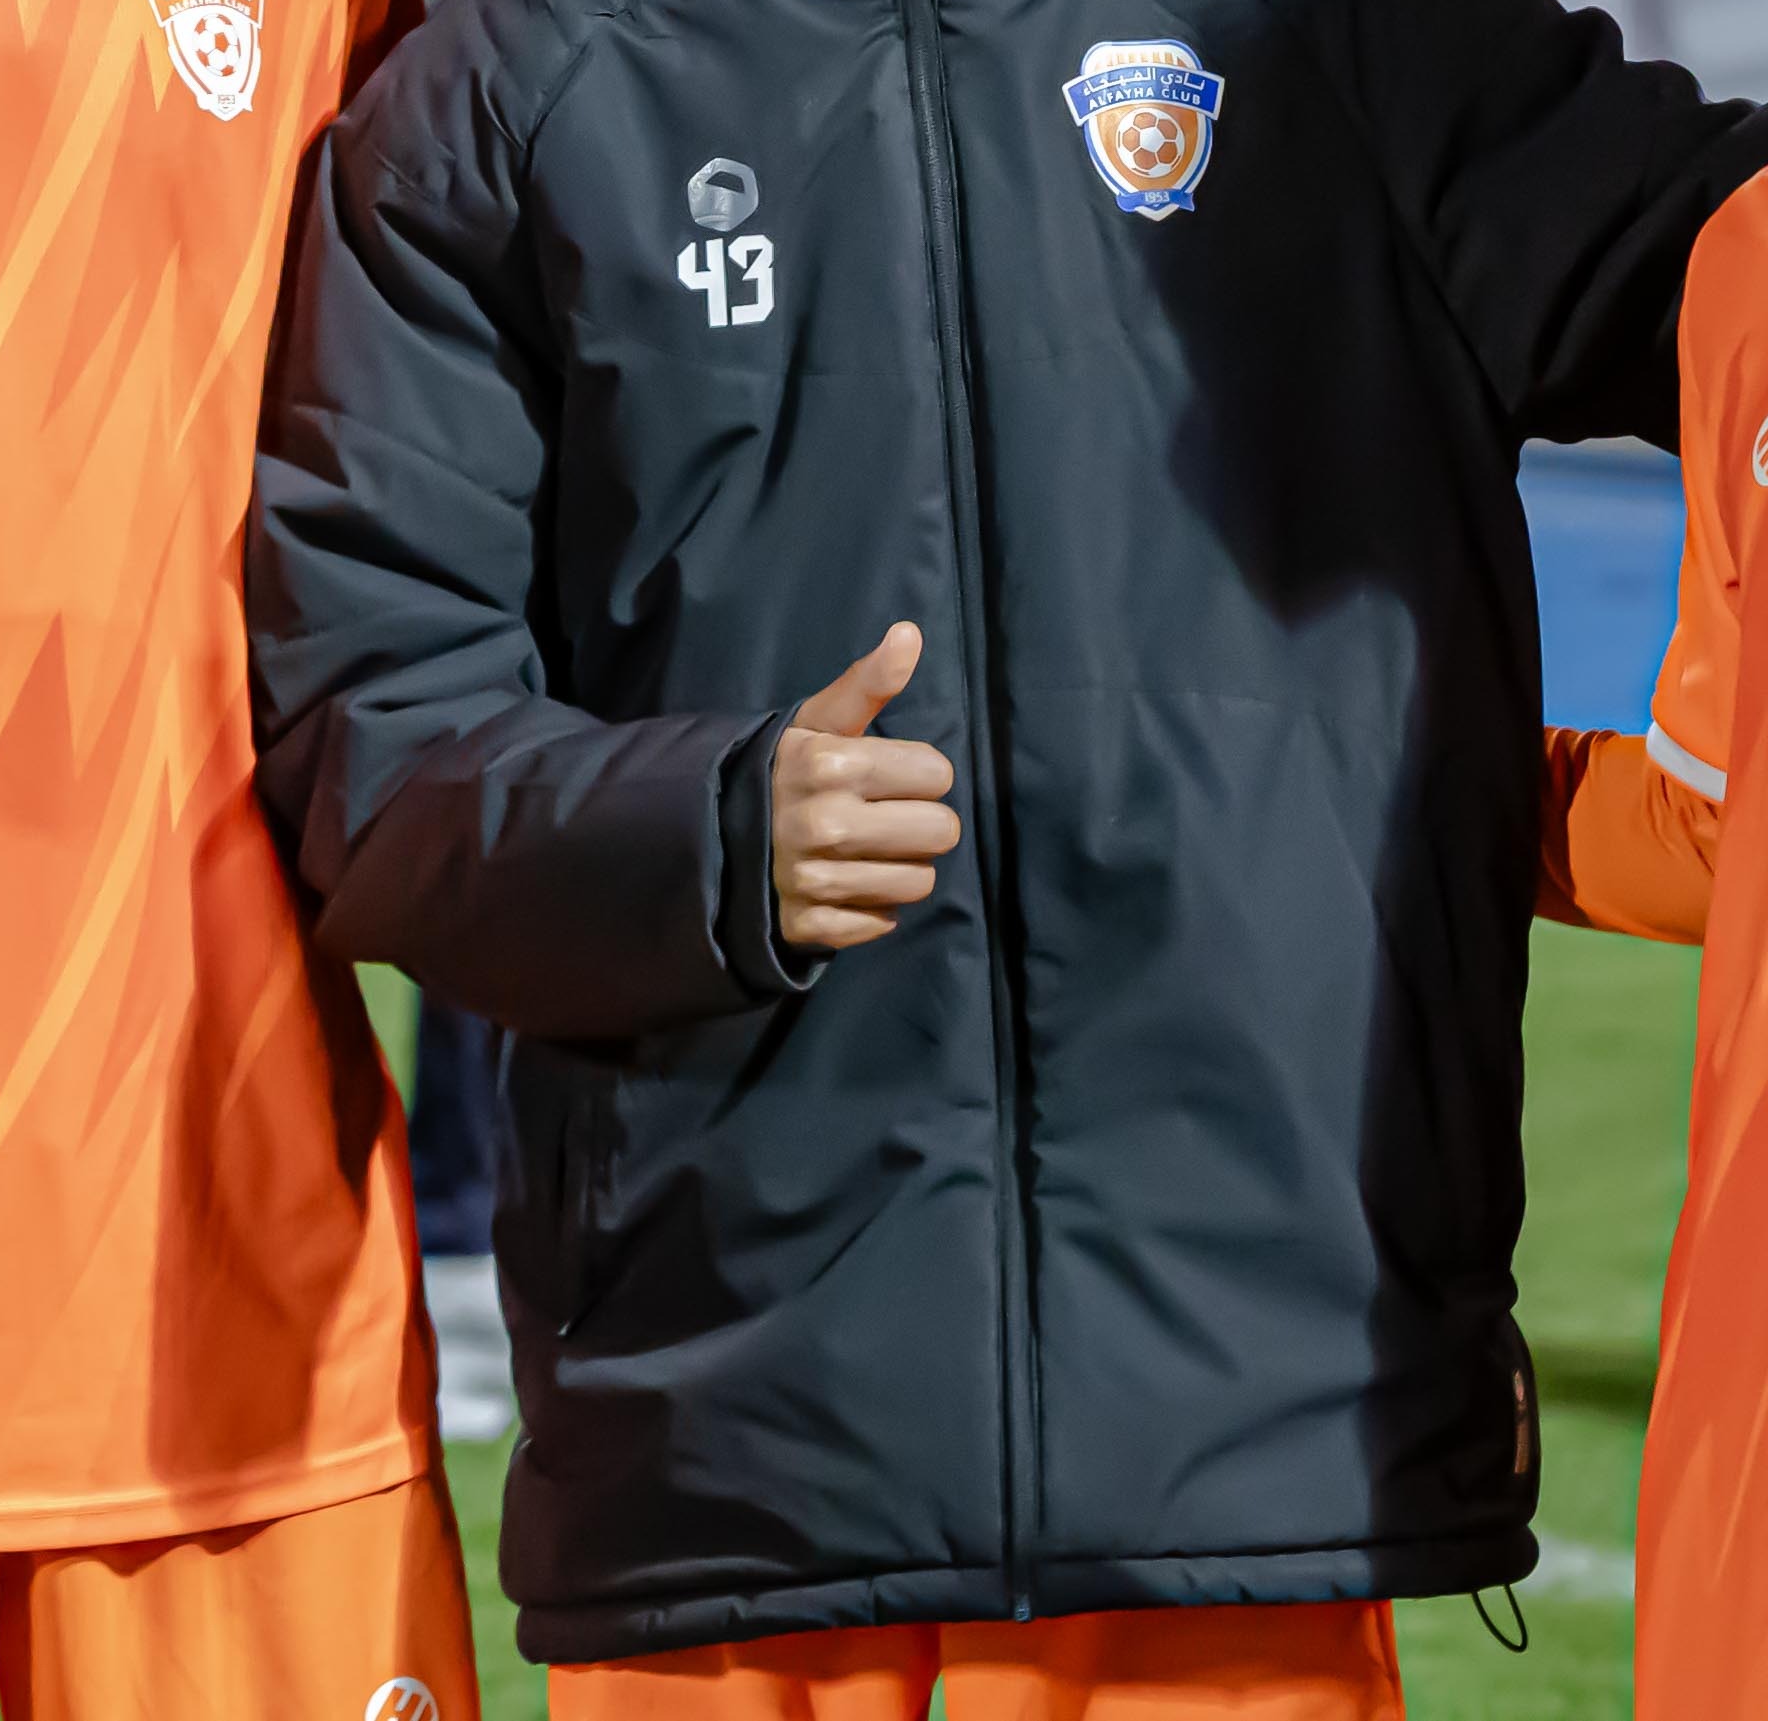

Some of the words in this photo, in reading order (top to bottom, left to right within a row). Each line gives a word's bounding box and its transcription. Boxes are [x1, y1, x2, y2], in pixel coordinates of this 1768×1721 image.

[1083, 67, 1156, 97] الفيحاء
[1088, 87, 1155, 111] ALFAYHA
[1161, 89, 1201, 105] CLUB
[1144, 191, 1170, 202] 1953
[677, 234, 775, 328] 43
